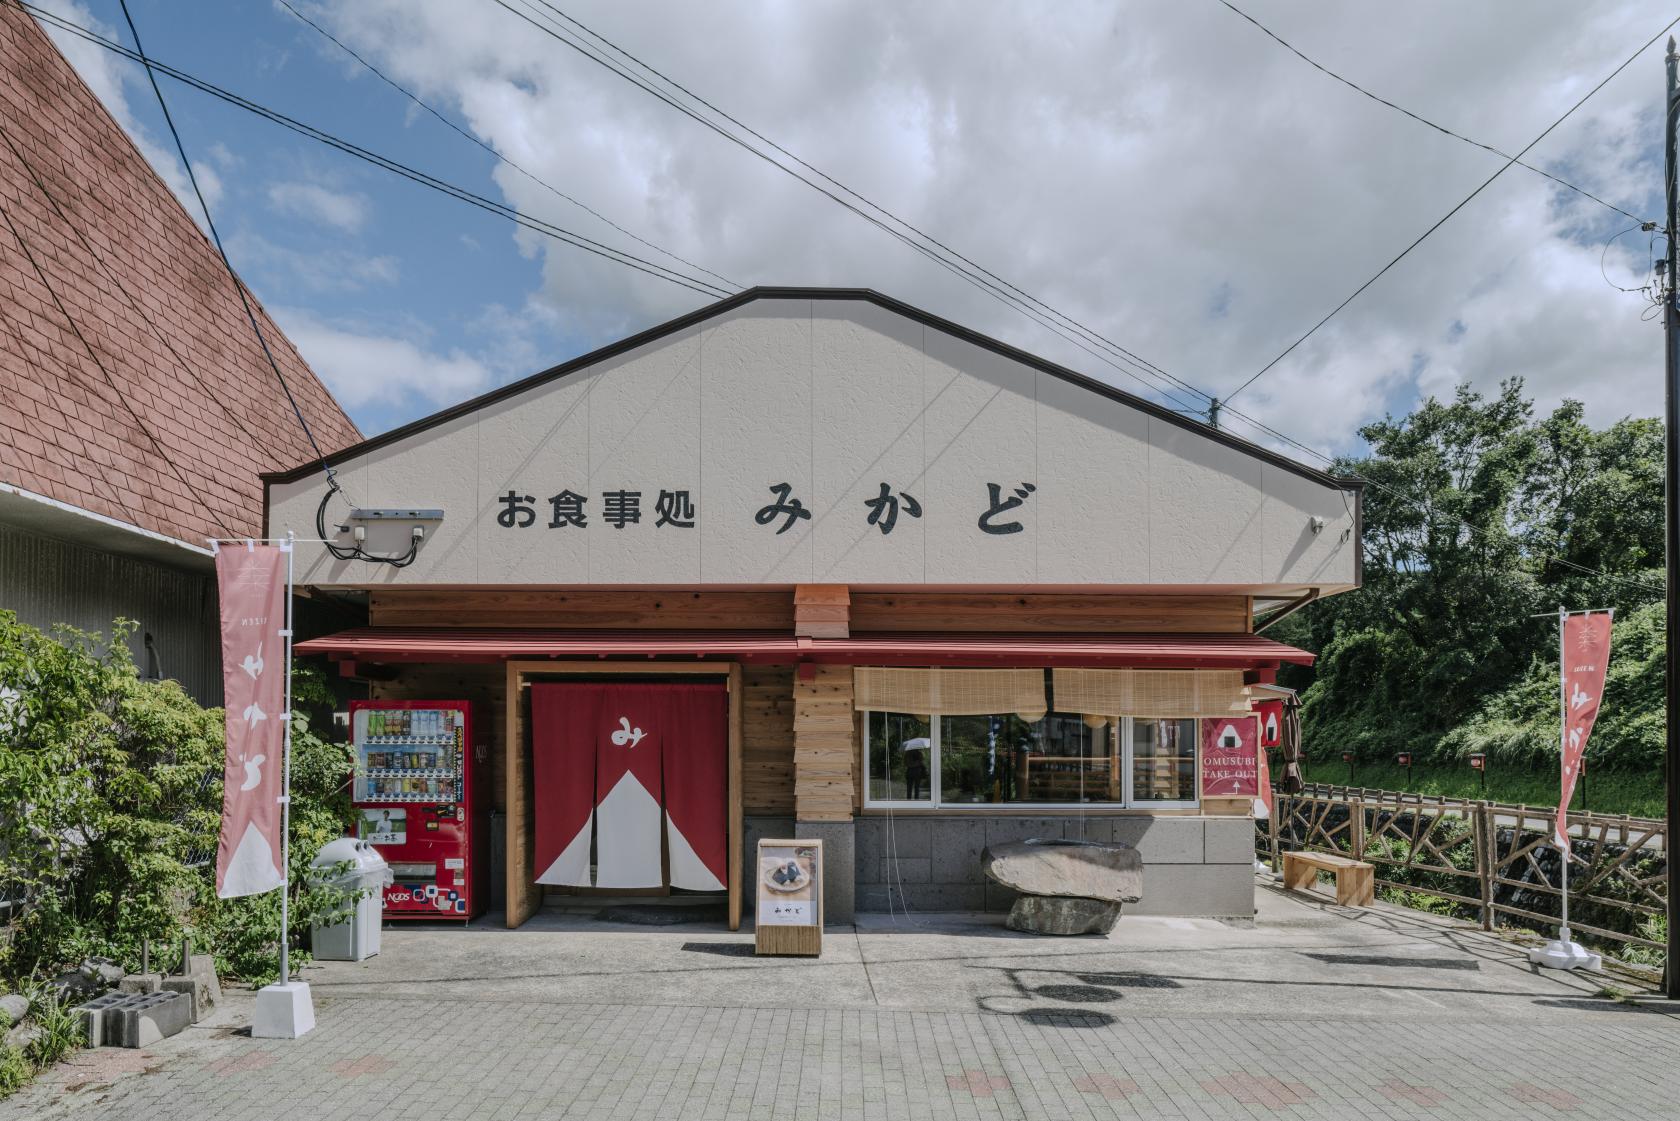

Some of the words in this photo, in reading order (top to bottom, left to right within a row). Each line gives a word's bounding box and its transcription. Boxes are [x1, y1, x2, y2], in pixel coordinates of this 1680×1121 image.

[496, 489, 695, 528] お食事処
[754, 482, 1037, 535] みかど
[611, 716, 648, 748] み
[1203, 757, 1256, 766] OMUSUBI
[1203, 770, 1230, 779] TAKE
[1234, 770, 1258, 779] OUT
